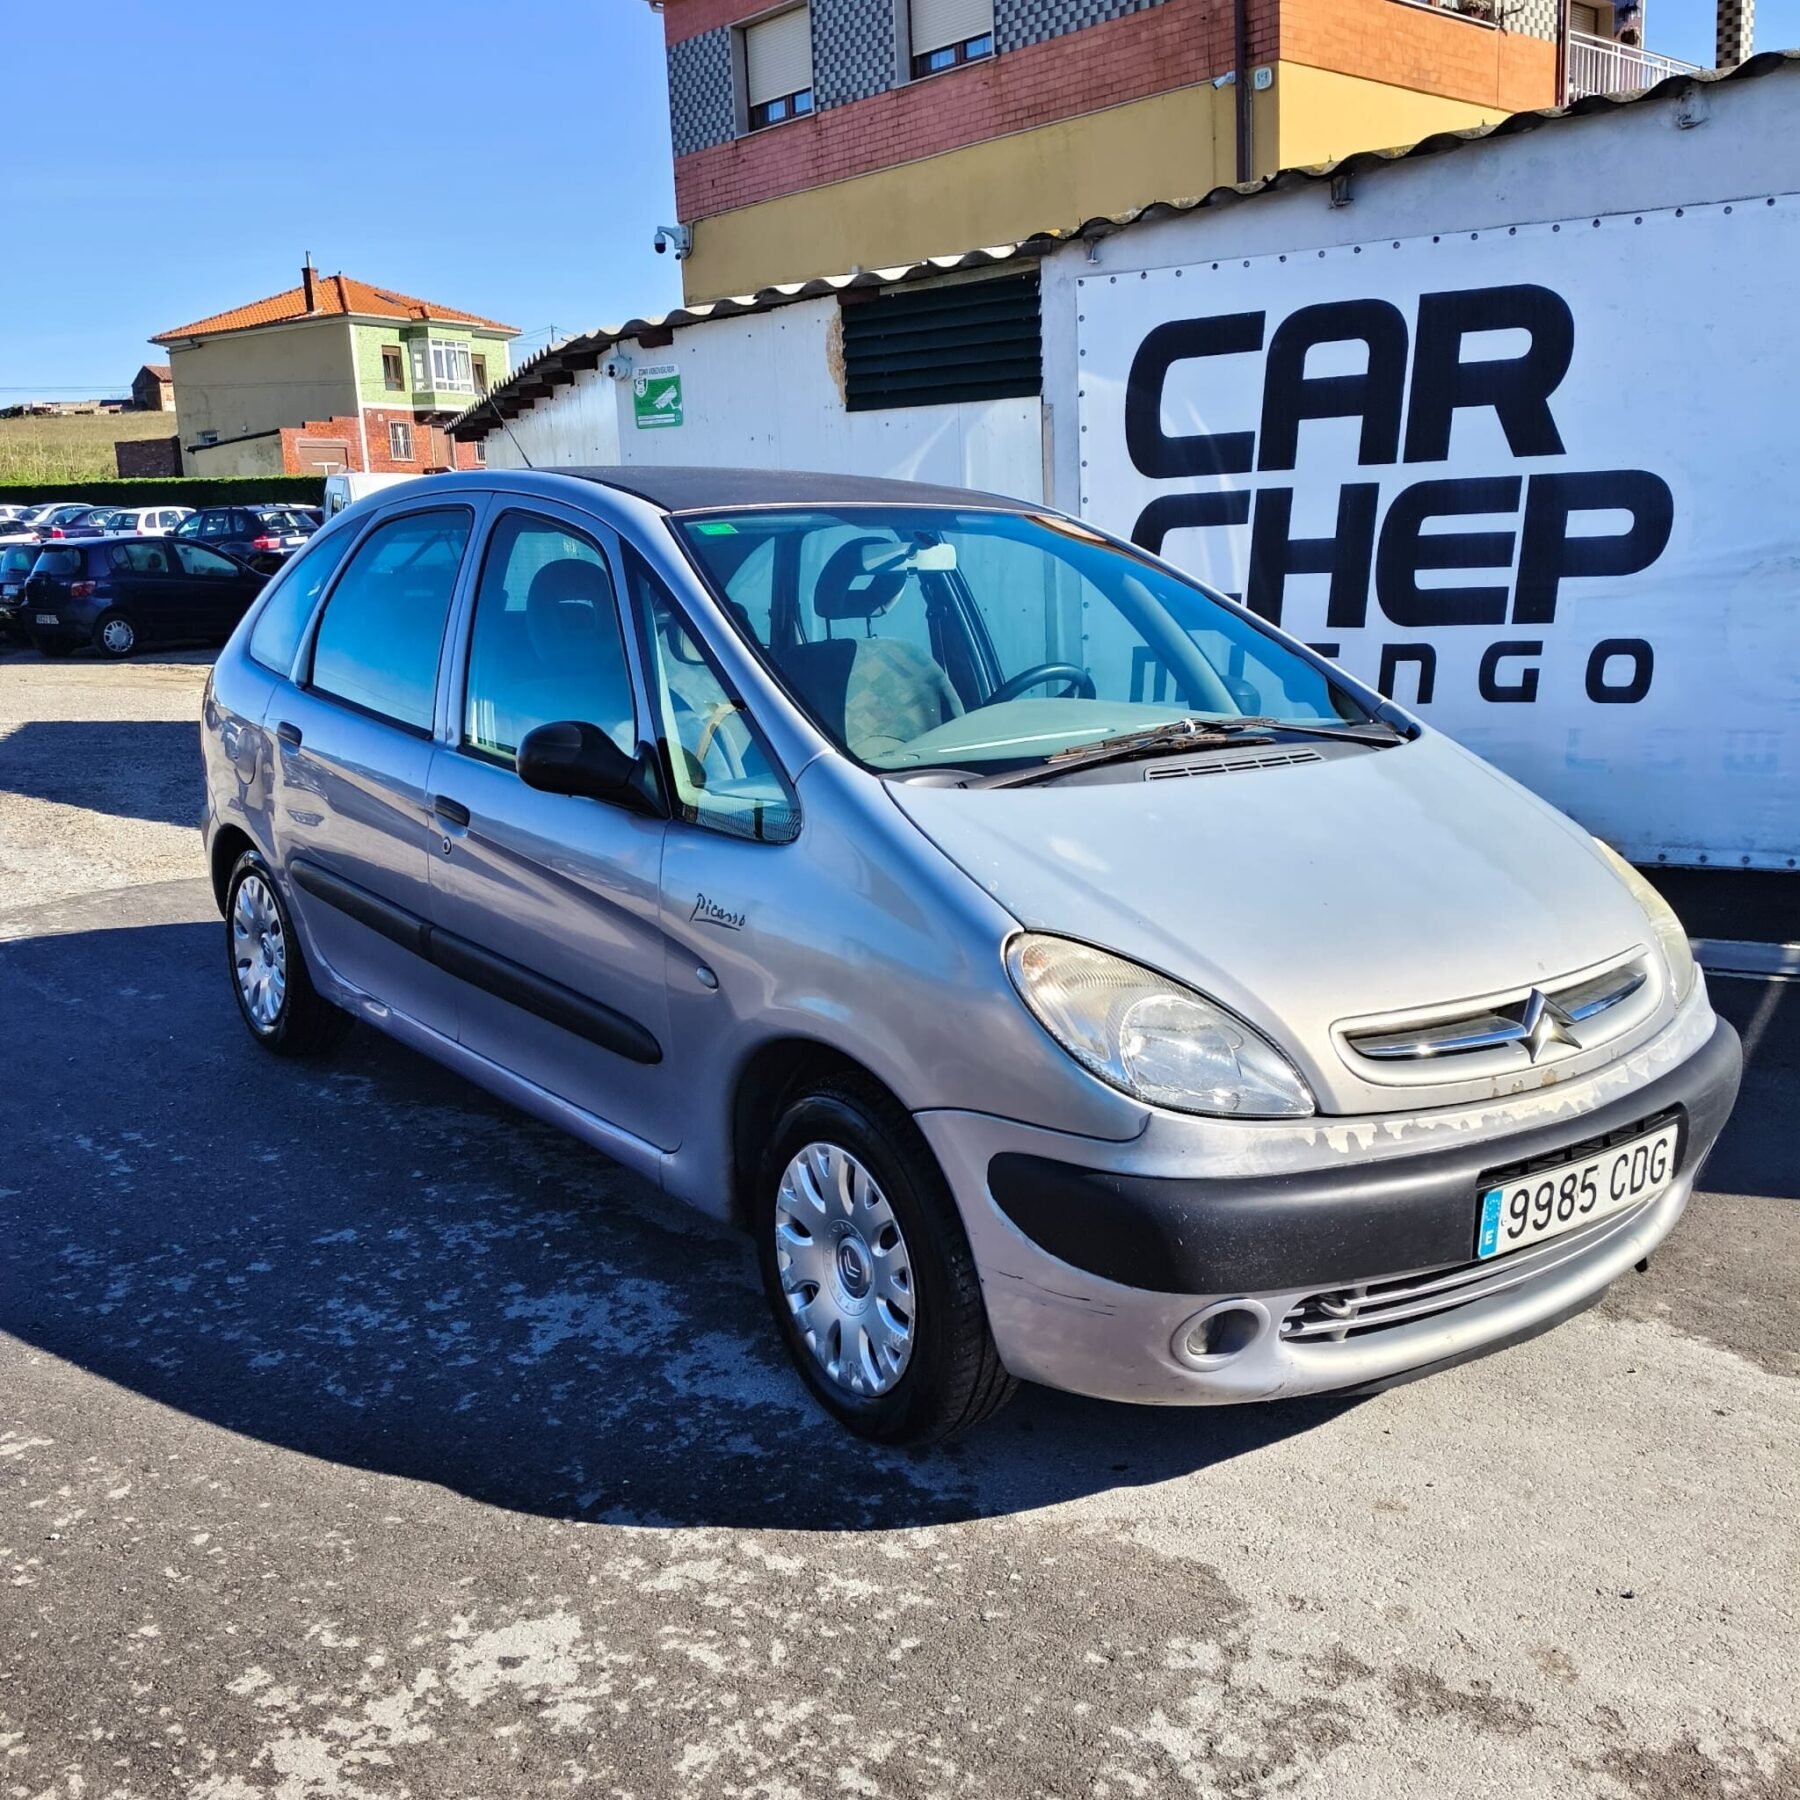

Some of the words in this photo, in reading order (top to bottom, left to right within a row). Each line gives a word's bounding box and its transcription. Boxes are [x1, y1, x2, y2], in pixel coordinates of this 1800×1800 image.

[1125, 284, 1575, 479] CAR
[689, 892, 746, 928] Picasso
[1485, 1229, 1494, 1245] E
[1507, 1165, 1598, 1239] 9985
[1609, 1138, 1668, 1202] CDG
